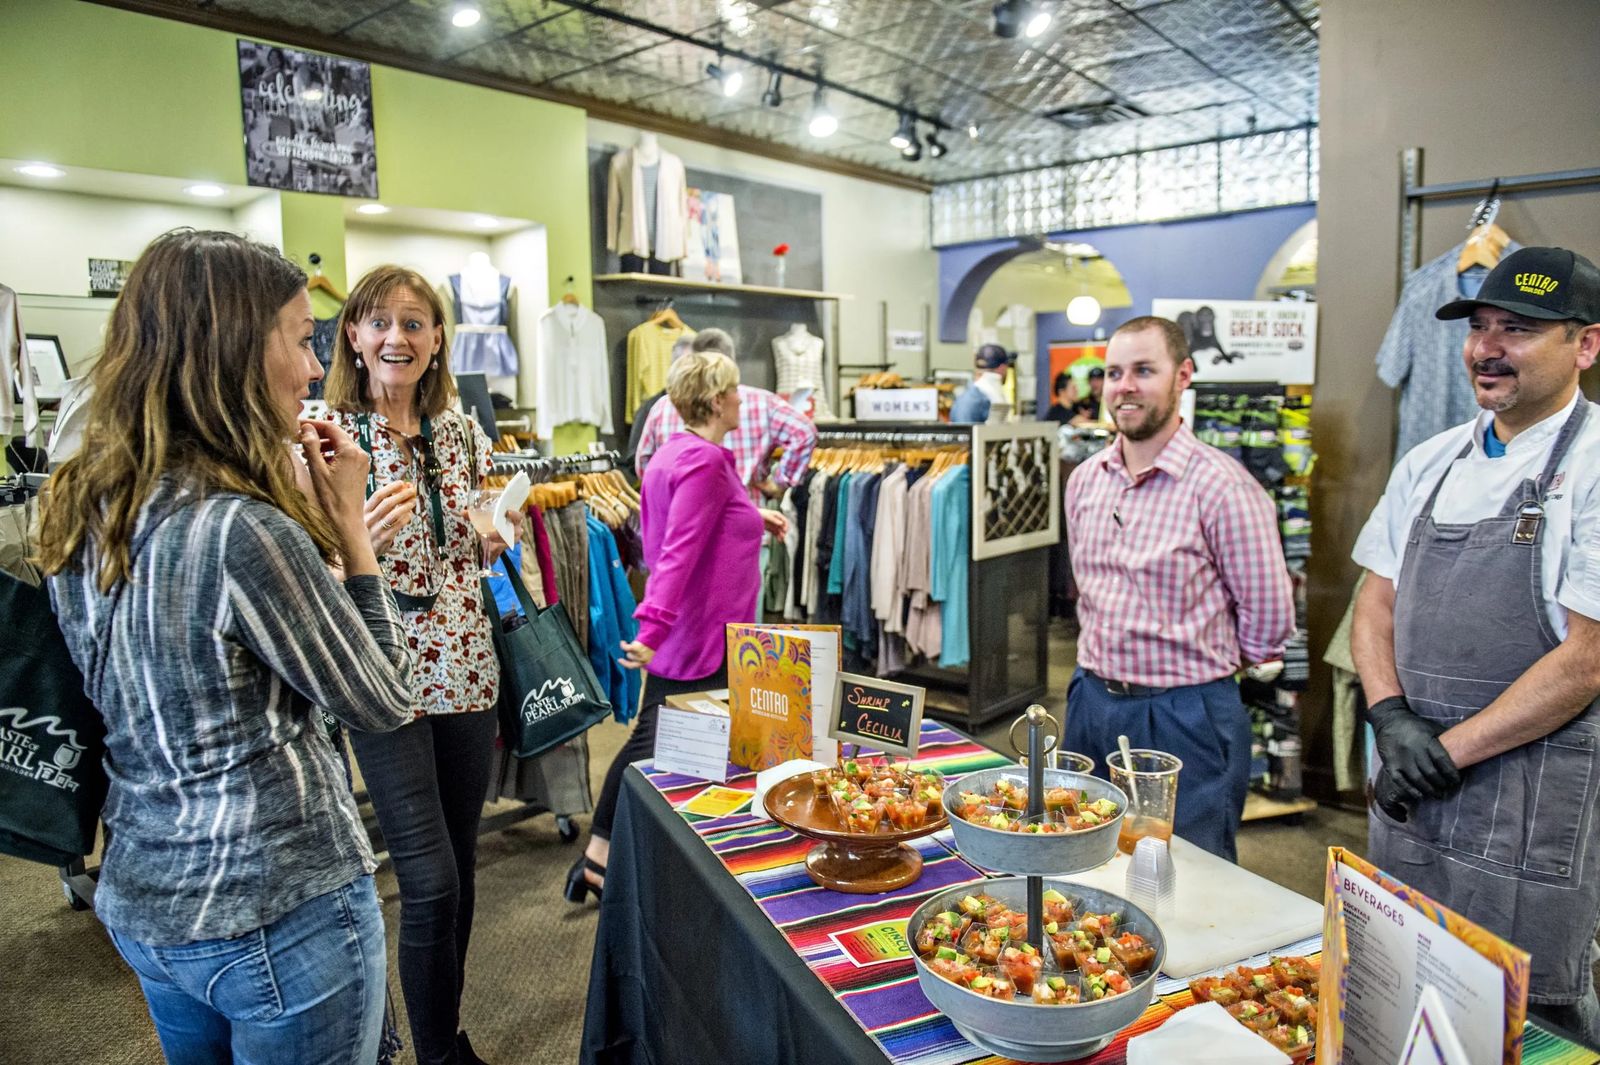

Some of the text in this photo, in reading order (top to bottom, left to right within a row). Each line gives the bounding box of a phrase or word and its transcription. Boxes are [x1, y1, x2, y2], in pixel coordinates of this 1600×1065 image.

[1515, 272, 1559, 293] CENTRO
[1230, 320, 1267, 337] GREAT
[872, 401, 930, 412] WOMEN'S
[524, 699, 563, 722] PEARL
[527, 695, 550, 711] TASTE
[750, 686, 789, 716] CENTRO
[1342, 900, 1371, 921] COCKTAILS
[1343, 877, 1405, 927] BEVERAGES
[881, 926, 909, 952] CINCO
